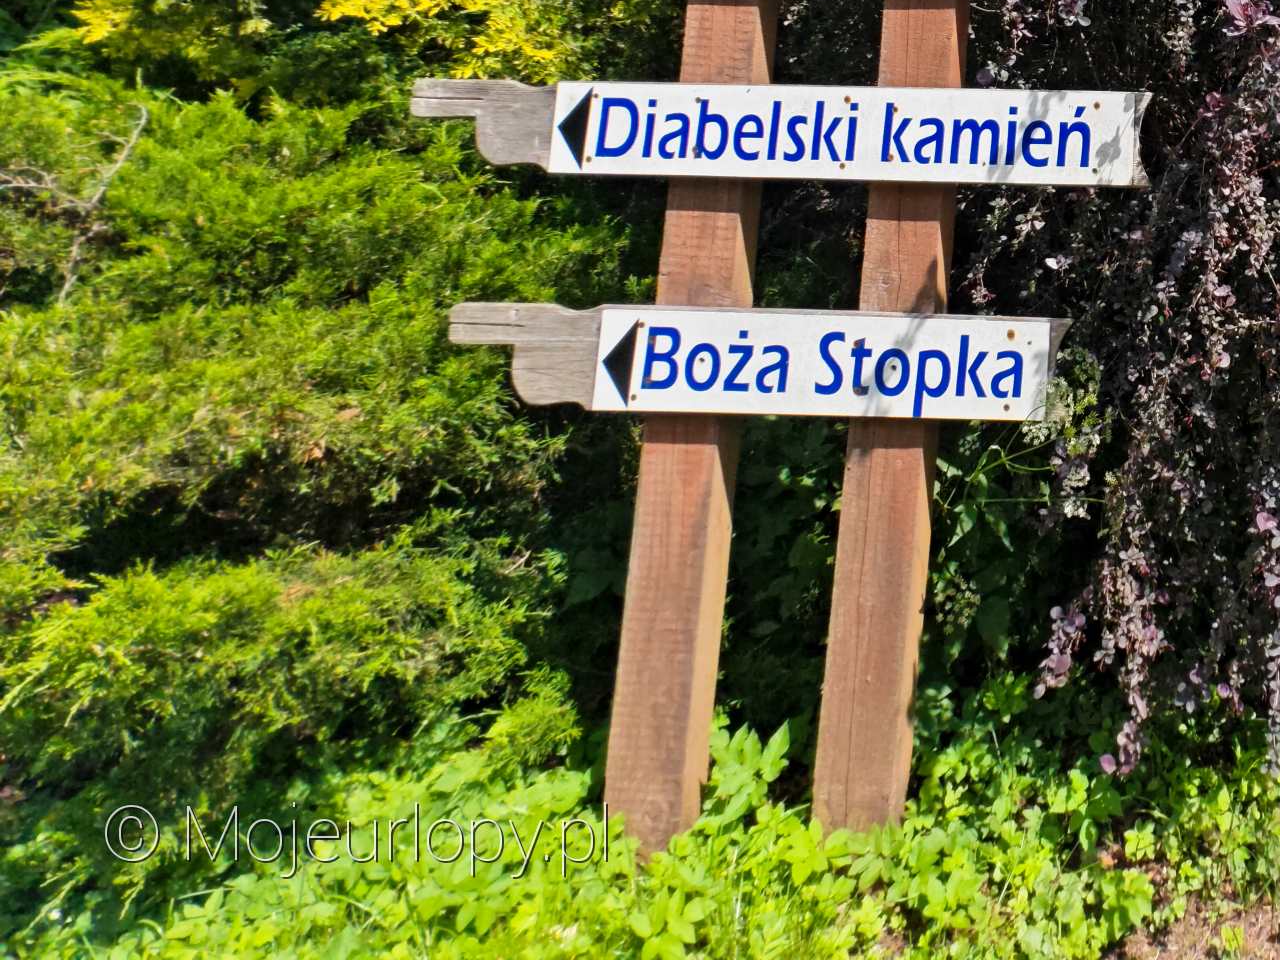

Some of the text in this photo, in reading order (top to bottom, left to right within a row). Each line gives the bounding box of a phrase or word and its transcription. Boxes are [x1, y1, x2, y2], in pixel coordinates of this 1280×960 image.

[595, 98, 1091, 168] Diabelski kamień
[641, 326, 1023, 418] Boża Stopka
